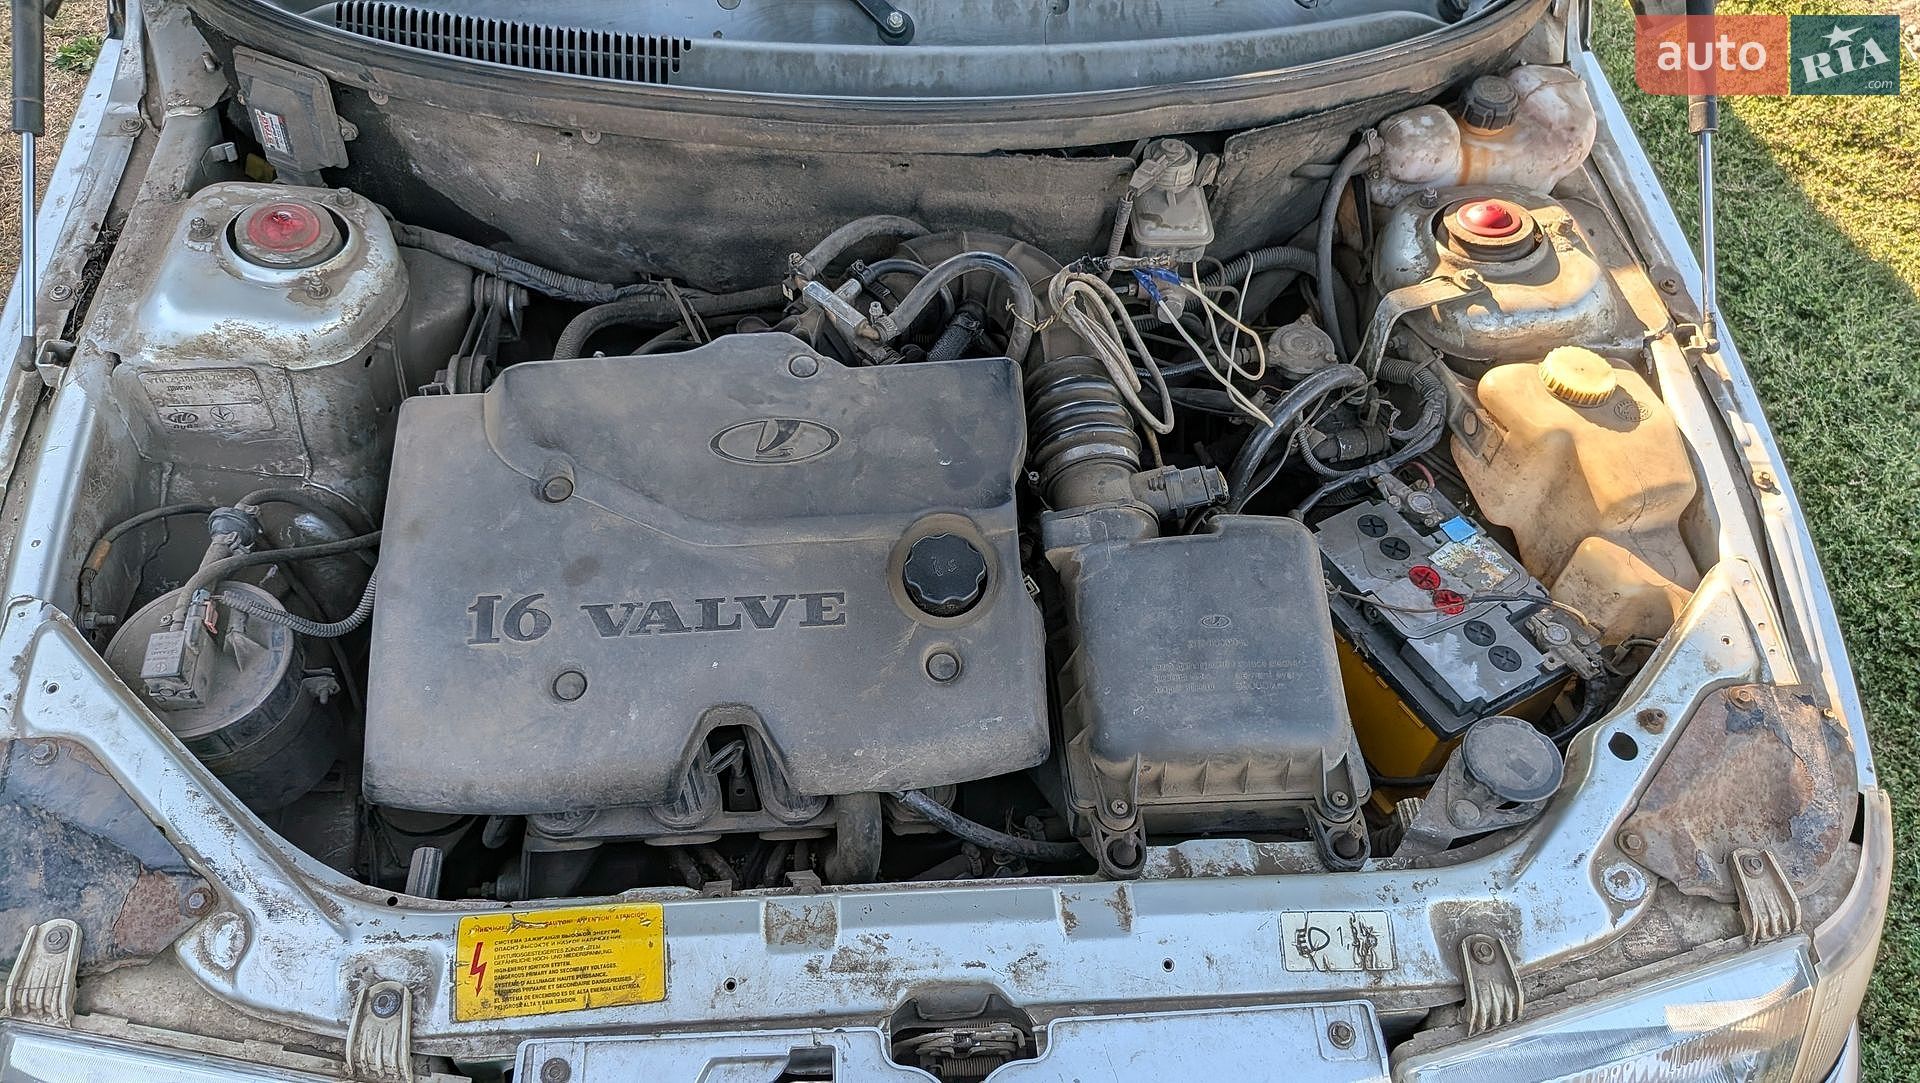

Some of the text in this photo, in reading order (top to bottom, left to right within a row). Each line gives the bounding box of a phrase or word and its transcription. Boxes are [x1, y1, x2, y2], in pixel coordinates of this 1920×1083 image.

[467, 592, 848, 645] 16 VALVE
[556, 981, 590, 989] SECONDAIRE
